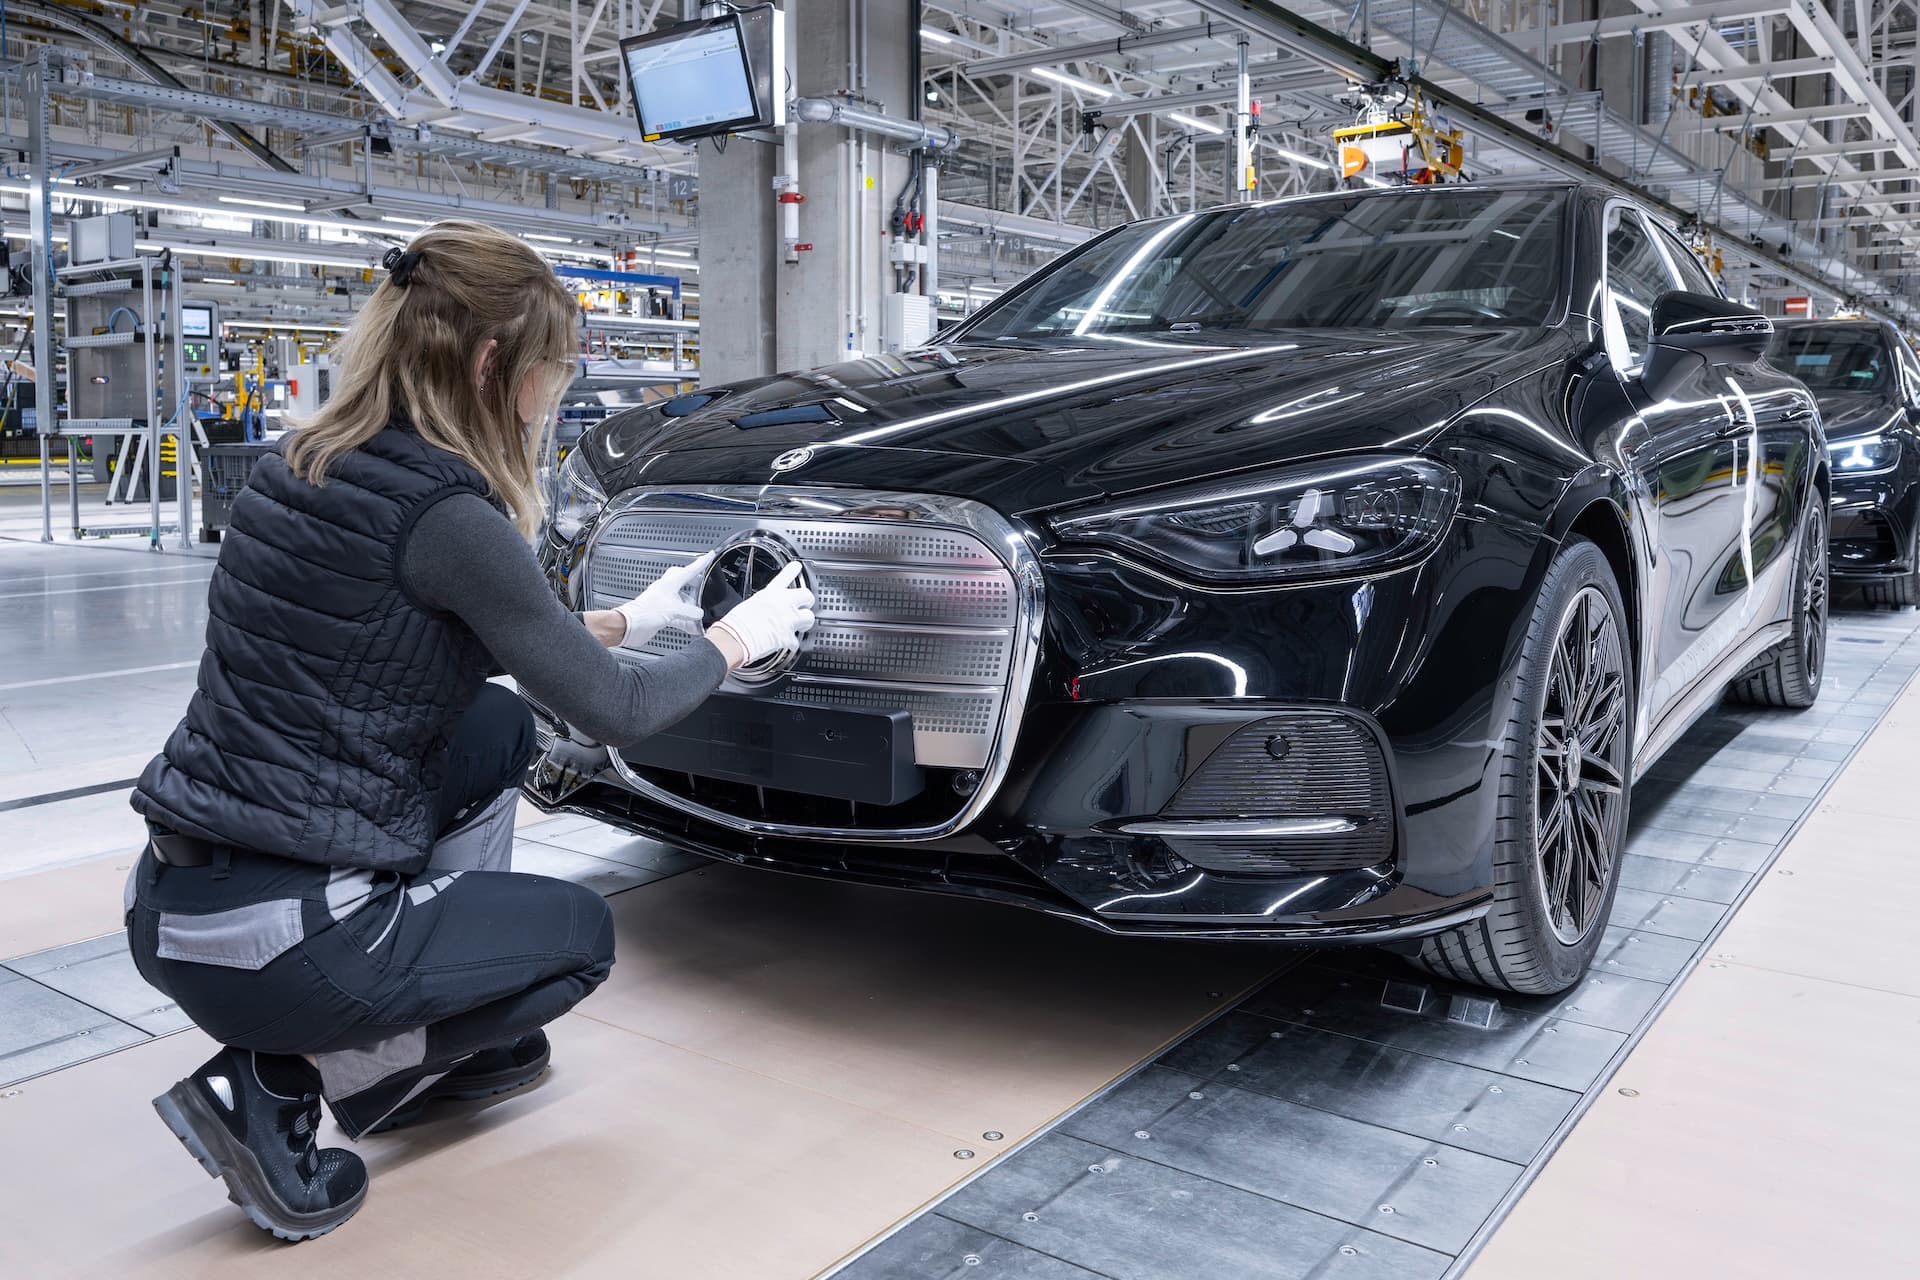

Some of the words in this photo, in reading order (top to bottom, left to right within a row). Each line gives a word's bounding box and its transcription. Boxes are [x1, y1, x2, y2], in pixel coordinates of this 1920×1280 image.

[26, 71, 37, 92] 11
[673, 180, 688, 195] 12
[1008, 239, 1020, 250] 13
[1529, 716, 1537, 738] XL
[1527, 741, 1535, 760] W
[1526, 765, 1534, 789] 20
[1525, 794, 1533, 804] R
